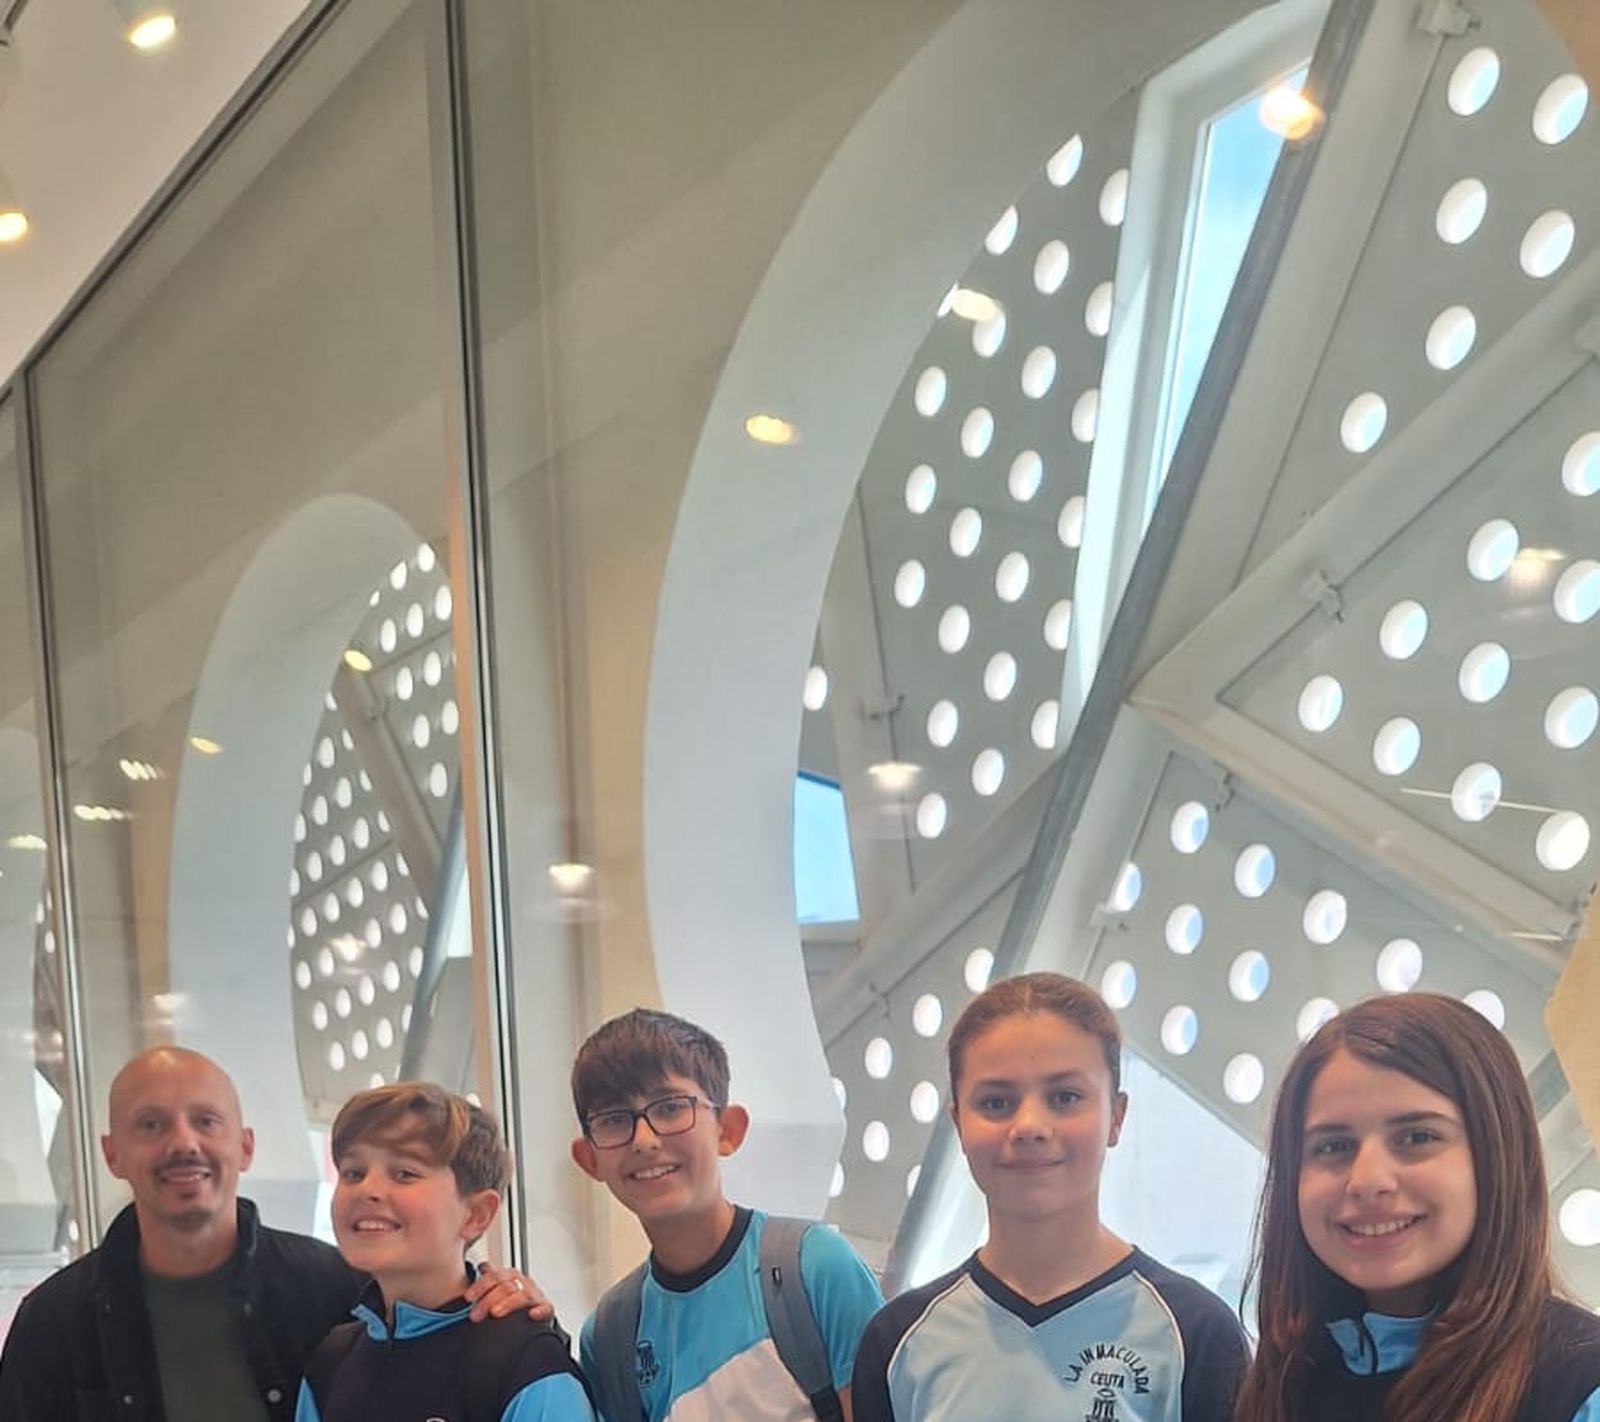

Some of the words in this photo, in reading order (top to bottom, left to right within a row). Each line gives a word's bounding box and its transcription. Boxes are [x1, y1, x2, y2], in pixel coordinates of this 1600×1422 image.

[1063, 1364, 1083, 1382] LA
[1079, 1343, 1150, 1394] INMACULADA
[1090, 1371, 1125, 1389] CEUTA
